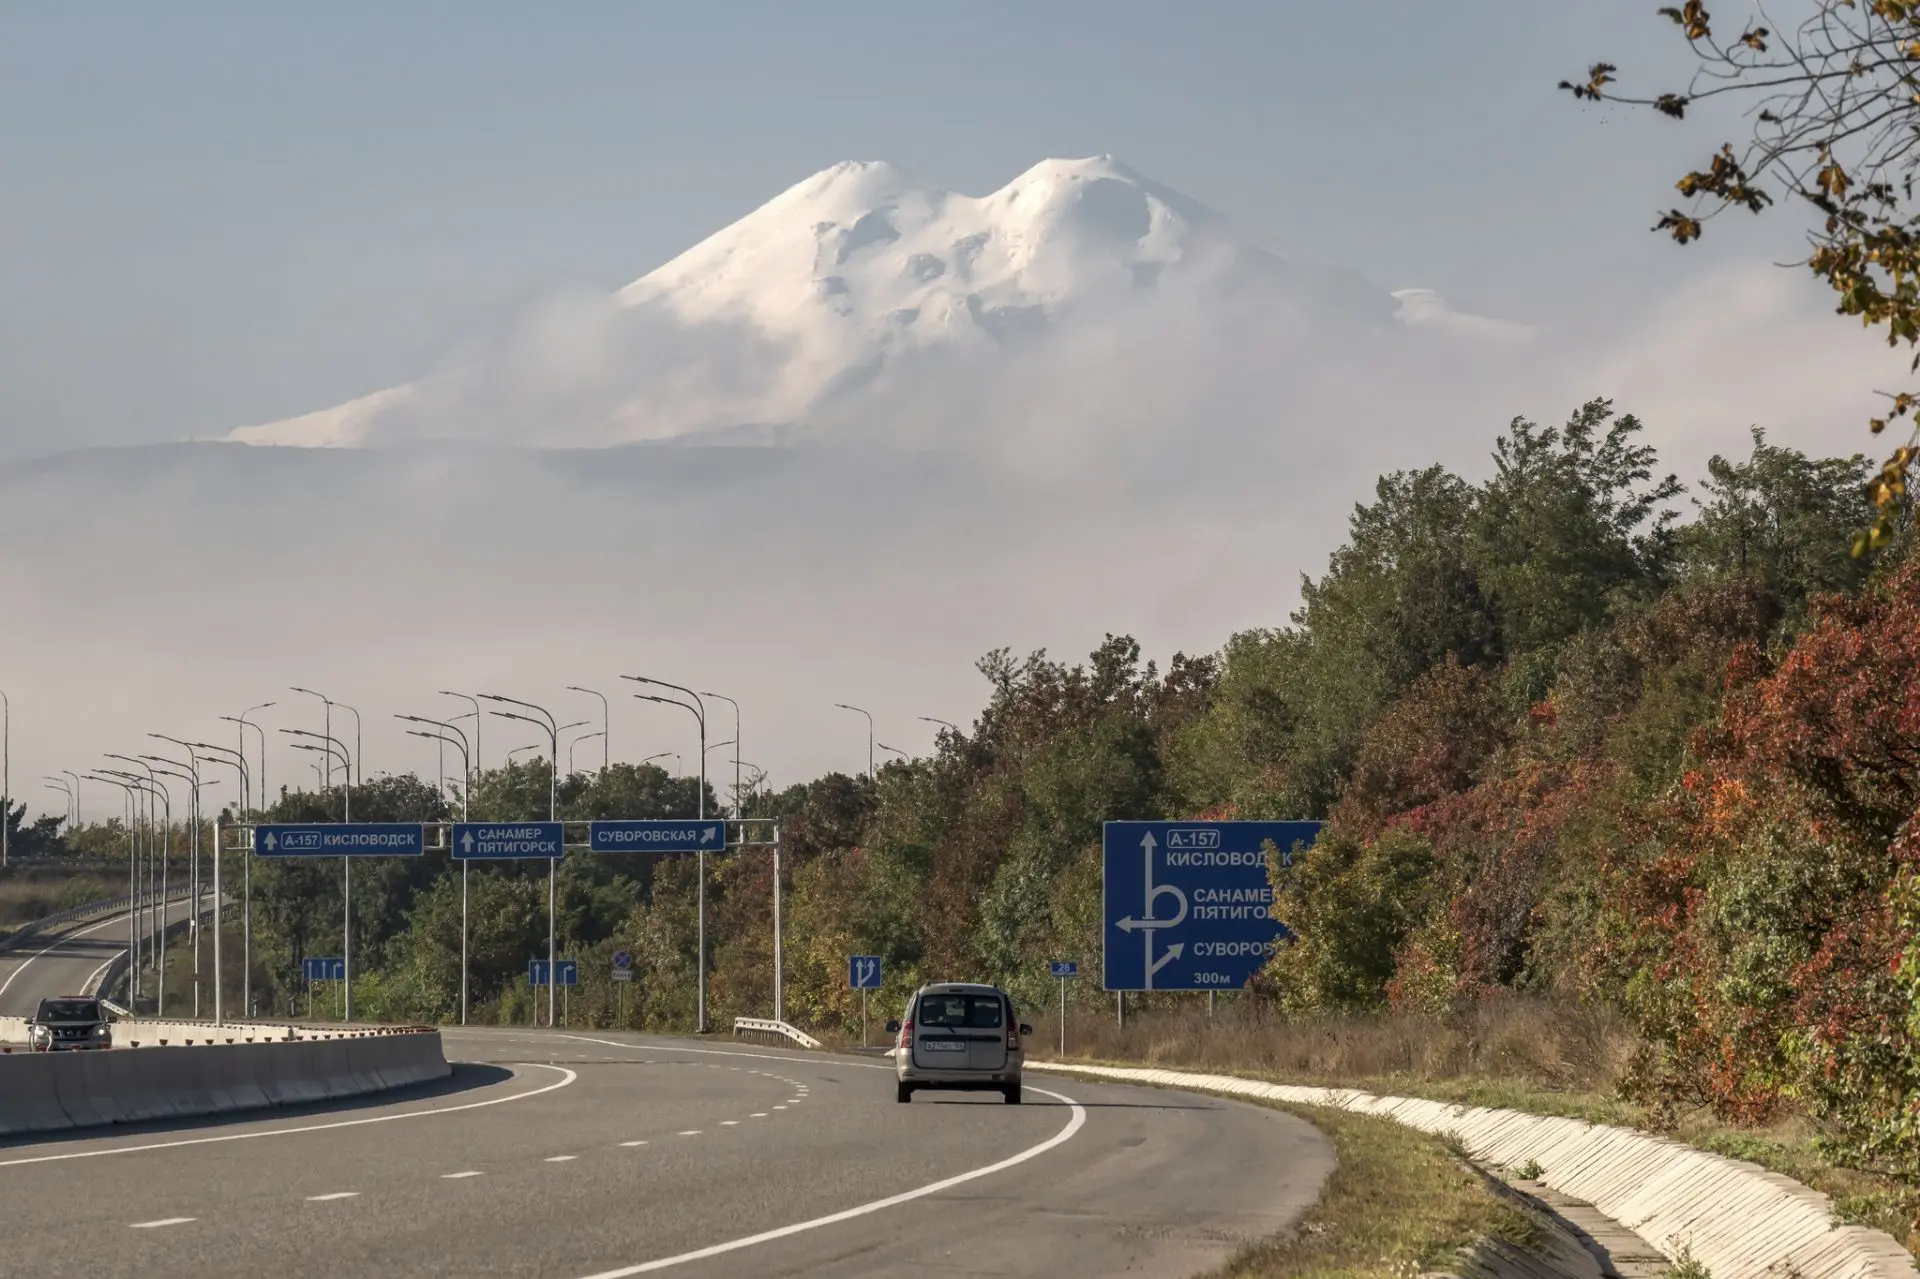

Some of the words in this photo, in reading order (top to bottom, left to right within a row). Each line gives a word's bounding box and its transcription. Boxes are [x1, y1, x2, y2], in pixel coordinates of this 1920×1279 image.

[284, 834, 318, 846] А-157
[324, 834, 415, 847] КИСЛОВОДСК
[477, 828, 542, 840] САНАМЕР
[598, 830, 697, 842] СУВОРОВСКАЯ
[1170, 832, 1217, 846] А-157
[477, 840, 556, 853] ПЯТИГОРСК
[1166, 852, 1293, 868] КИСЛОВОДК
[1194, 888, 1275, 903] САНАМЕ
[1194, 973, 1231, 984] 300м
